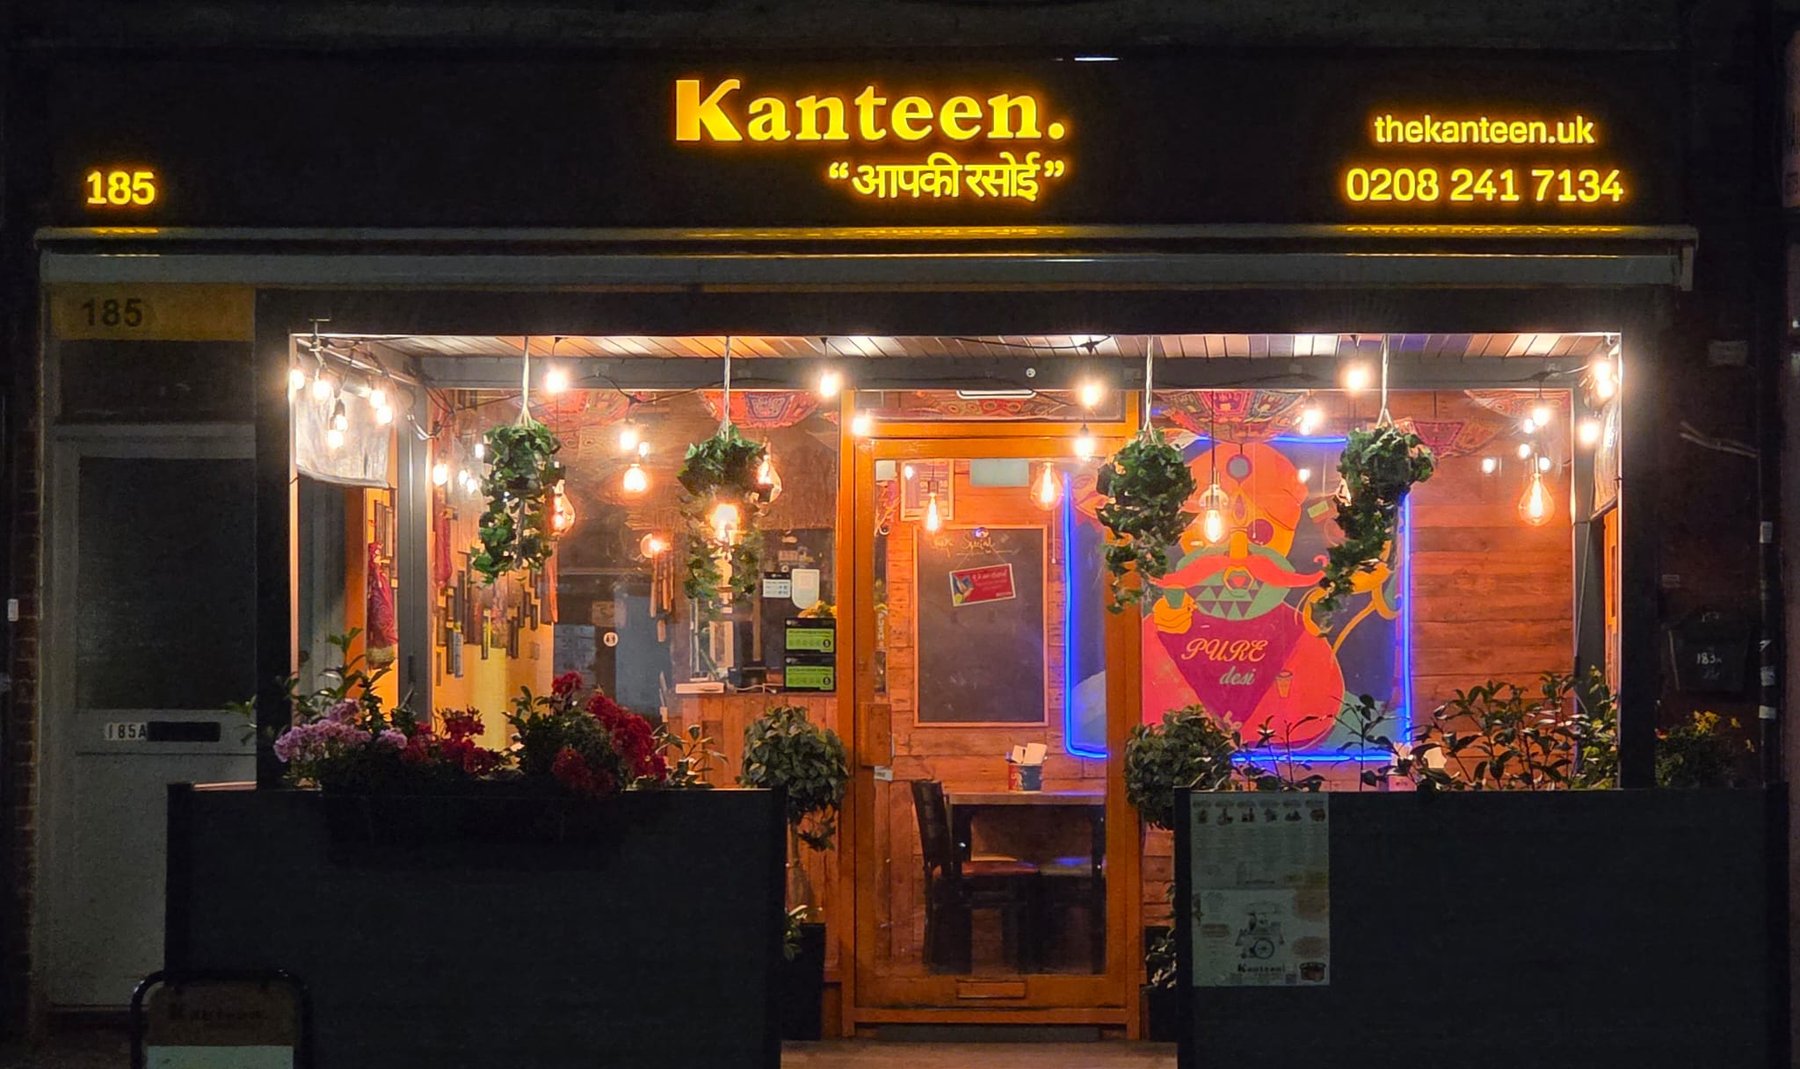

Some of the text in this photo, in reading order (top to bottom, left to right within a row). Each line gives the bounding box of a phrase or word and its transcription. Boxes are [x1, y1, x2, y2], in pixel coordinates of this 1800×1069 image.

[676, 79, 1065, 141] Kanteen.
[1374, 115, 1595, 144] thekanteen.uk
[86, 170, 156, 206] 185
[1346, 168, 1624, 202] 0208 241 7134
[82, 298, 144, 328] 185
[1181, 638, 1268, 662] PURE
[1219, 665, 1257, 686] desi
[109, 723, 146, 739] 185A
